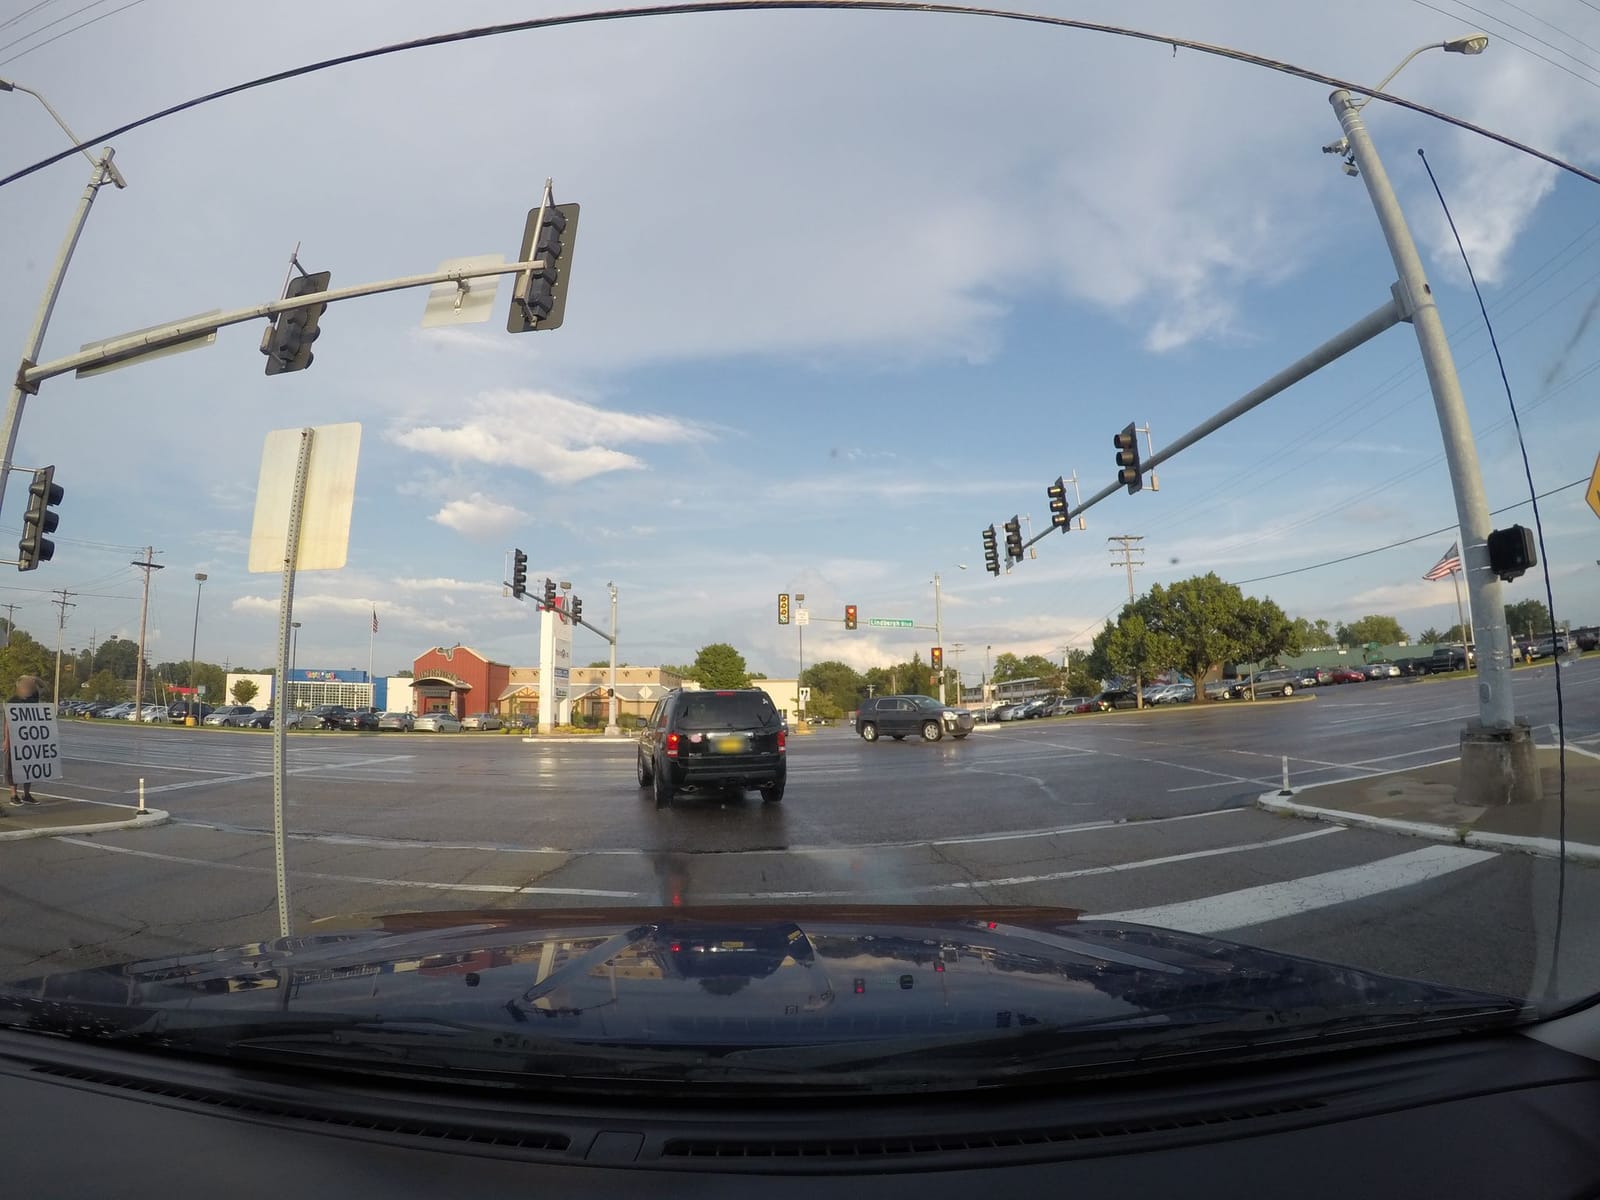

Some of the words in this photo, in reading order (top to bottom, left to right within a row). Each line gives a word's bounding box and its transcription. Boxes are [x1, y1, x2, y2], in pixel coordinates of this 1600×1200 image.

[10, 707, 52, 721] SMILE
[18, 725, 50, 740] GOD
[14, 744, 58, 761] LOVES
[23, 763, 52, 780] YOU
